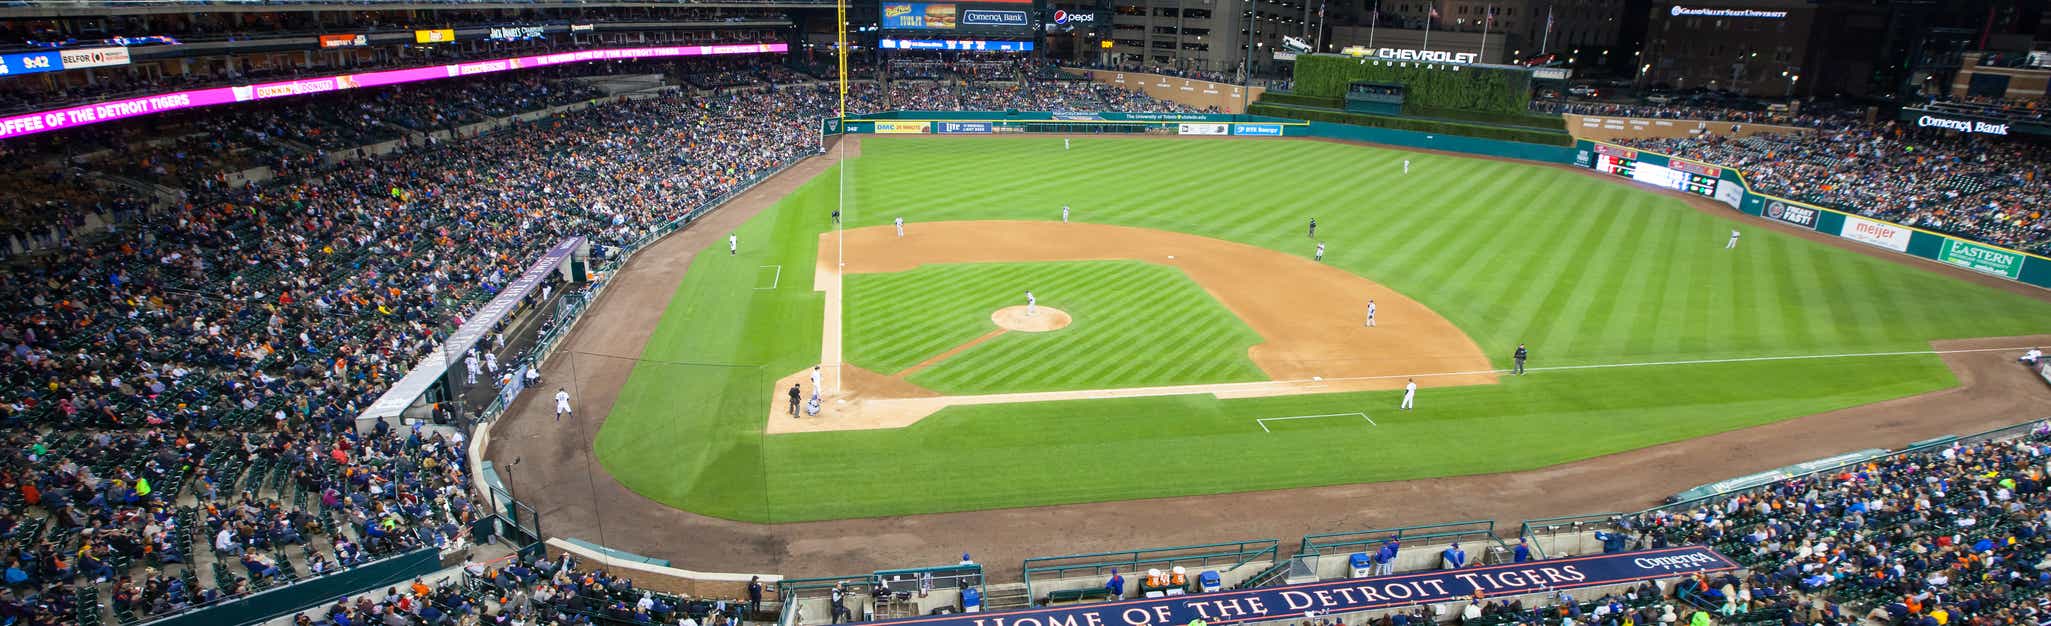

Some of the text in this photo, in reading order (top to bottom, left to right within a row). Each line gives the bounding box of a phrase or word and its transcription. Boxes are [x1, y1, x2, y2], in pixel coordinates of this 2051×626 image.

[1003, 13, 1023, 21] Bank
[1068, 13, 1094, 23] pepsi
[63, 54, 90, 64] BELFOR
[1379, 48, 1477, 64] CHEVROLET
[1360, 60, 1460, 71] FOUNTAIN
[45, 112, 65, 127] OF
[68, 108, 96, 123] THE
[97, 99, 149, 118] DETROIT
[150, 94, 190, 110] TIGERS
[1974, 121, 2010, 135] Bank
[1856, 221, 1896, 240] meijer
[1951, 240, 2015, 266] EASTERN
[1122, 605, 1172, 626] OF
[1187, 596, 1268, 619] THE
[1279, 578, 1450, 611] DETROIT
[1455, 564, 1586, 594] TIGERS
